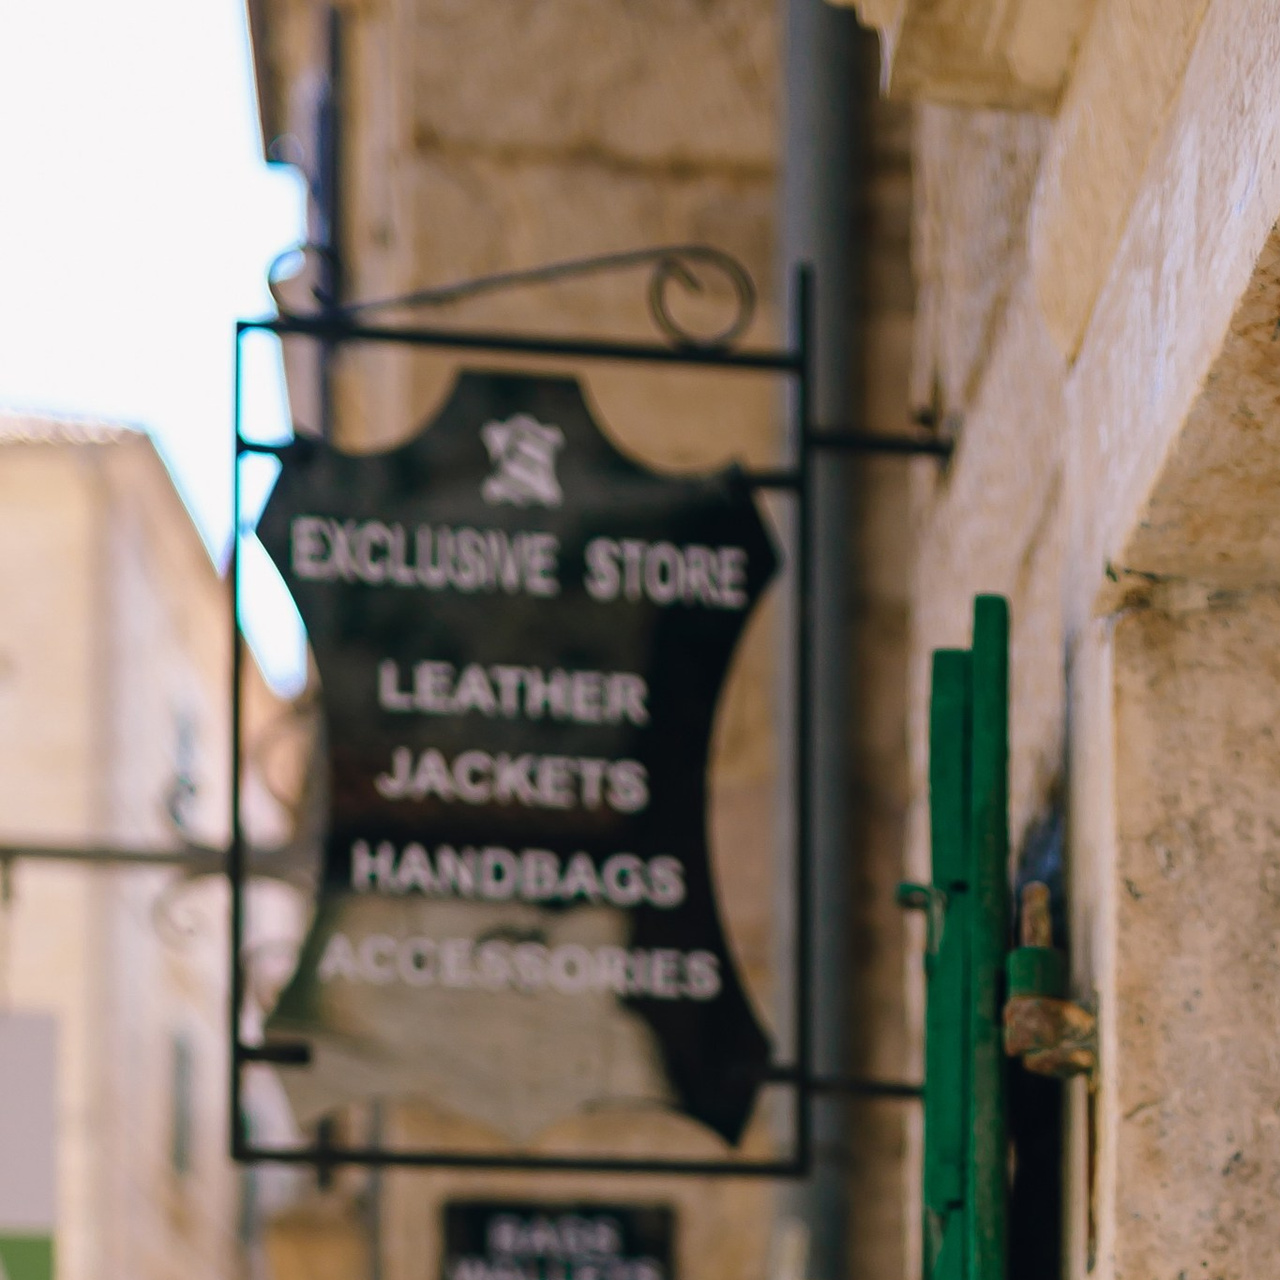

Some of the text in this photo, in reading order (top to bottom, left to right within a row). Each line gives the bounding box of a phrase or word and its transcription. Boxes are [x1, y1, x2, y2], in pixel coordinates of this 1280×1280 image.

[293, 515, 748, 609] EXCLUSIVE STORE
[377, 659, 649, 724] LEATHER
[374, 746, 650, 813] JACKETS
[350, 839, 686, 908] HANDBAGS
[319, 933, 723, 1001] ACCESSORIES
